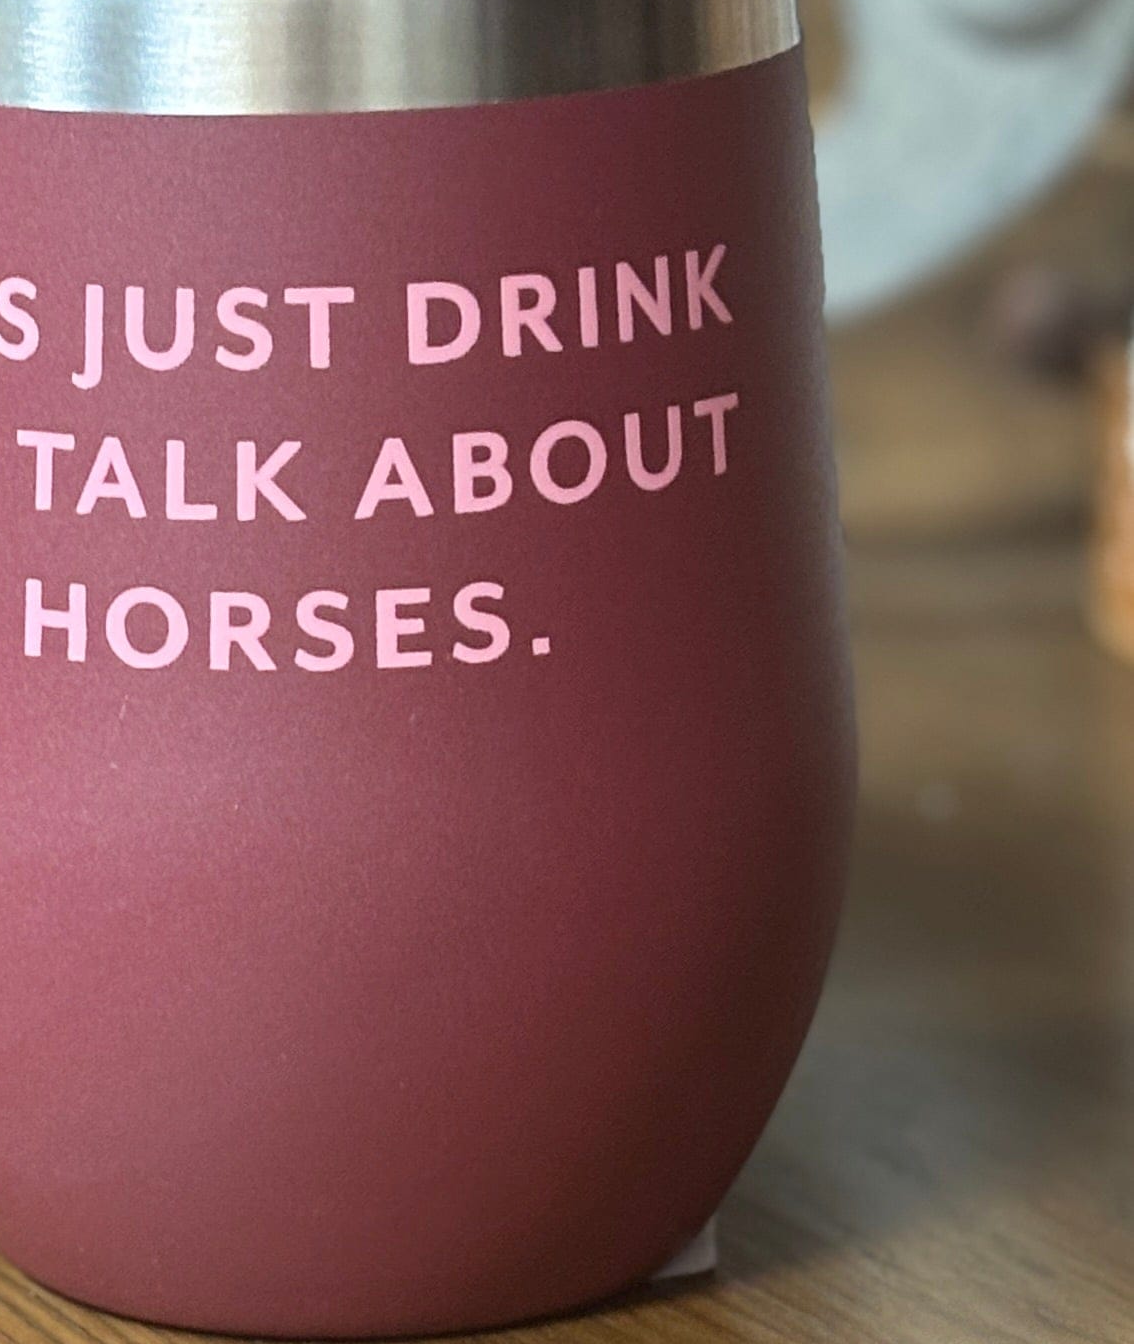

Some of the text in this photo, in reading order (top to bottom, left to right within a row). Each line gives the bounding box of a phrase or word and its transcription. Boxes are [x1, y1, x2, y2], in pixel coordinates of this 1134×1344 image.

[71, 284, 355, 391] JUST
[407, 243, 734, 367] DRINK
[16, 429, 308, 523] TALK
[353, 391, 739, 521] ABOUT
[23, 577, 551, 673] HORSES.
